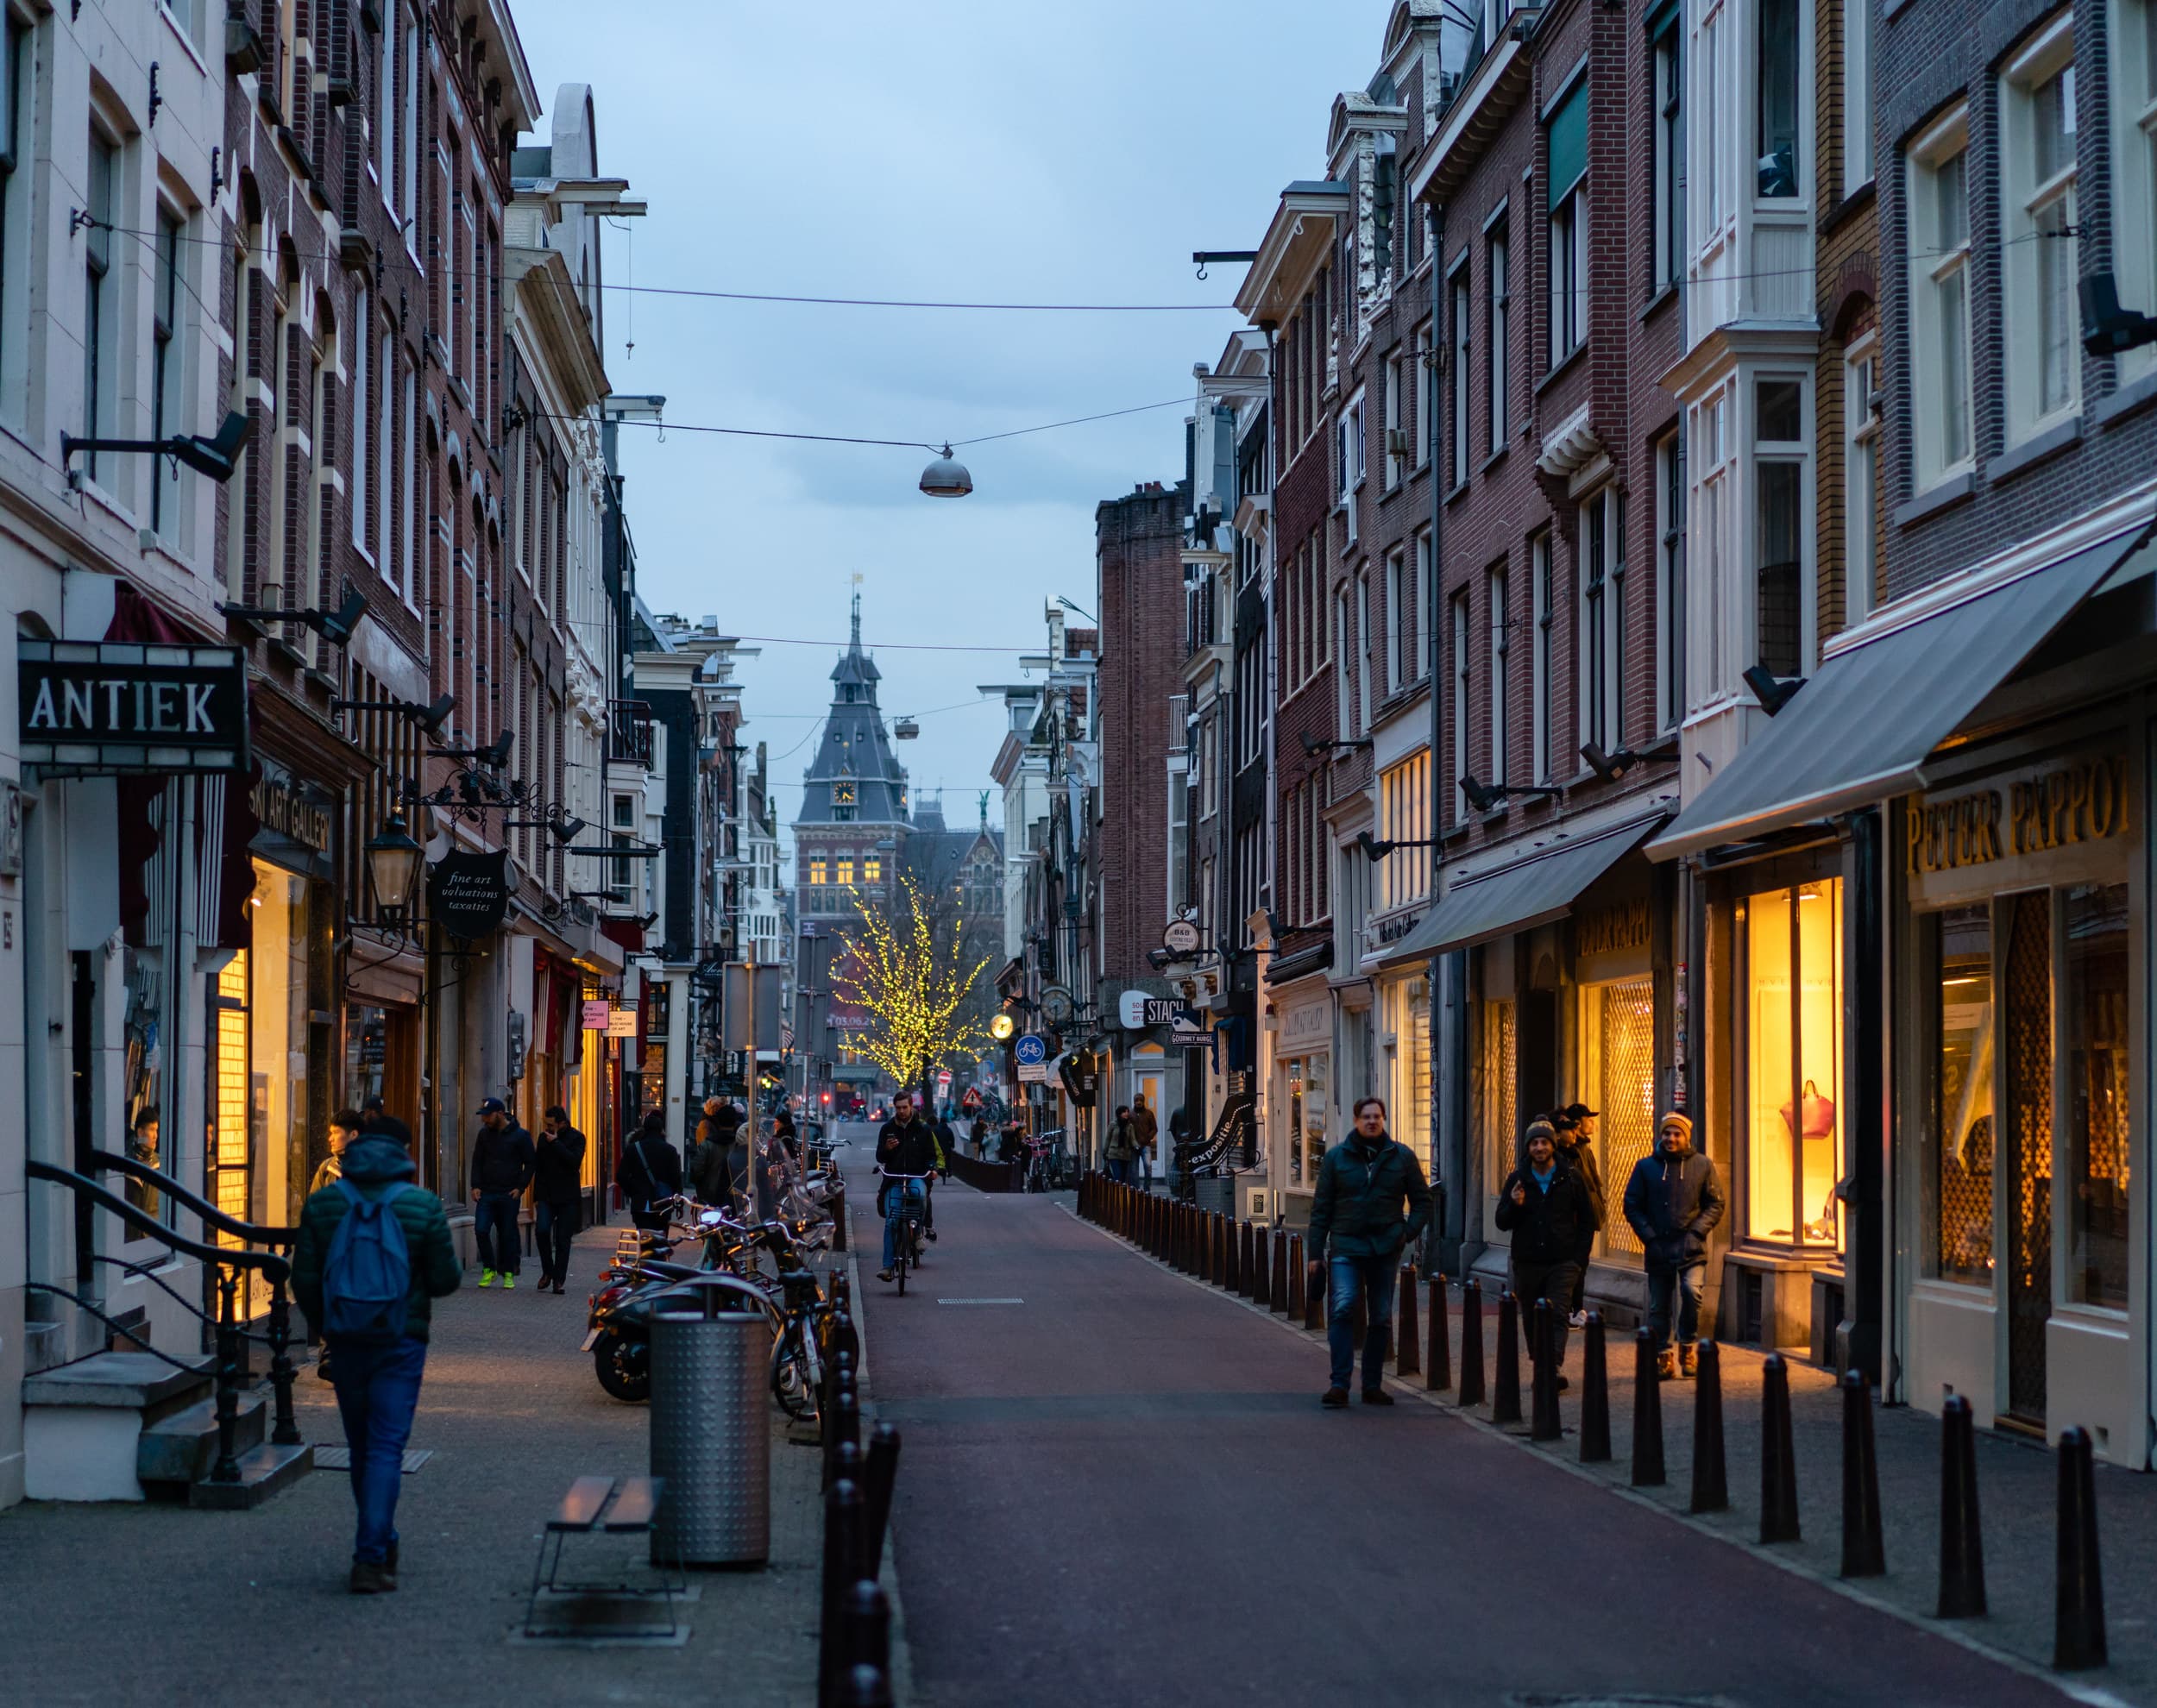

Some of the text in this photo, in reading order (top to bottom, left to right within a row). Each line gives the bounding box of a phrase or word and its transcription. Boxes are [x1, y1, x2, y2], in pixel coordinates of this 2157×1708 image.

[27, 677, 216, 732] ANTIEK
[269, 786, 290, 833] ART
[292, 798, 330, 853] GALLERY
[1906, 791, 2000, 876] PETER
[442, 885, 498, 899] valuations
[448, 870, 471, 887] fine
[449, 900, 490, 912] taxaties
